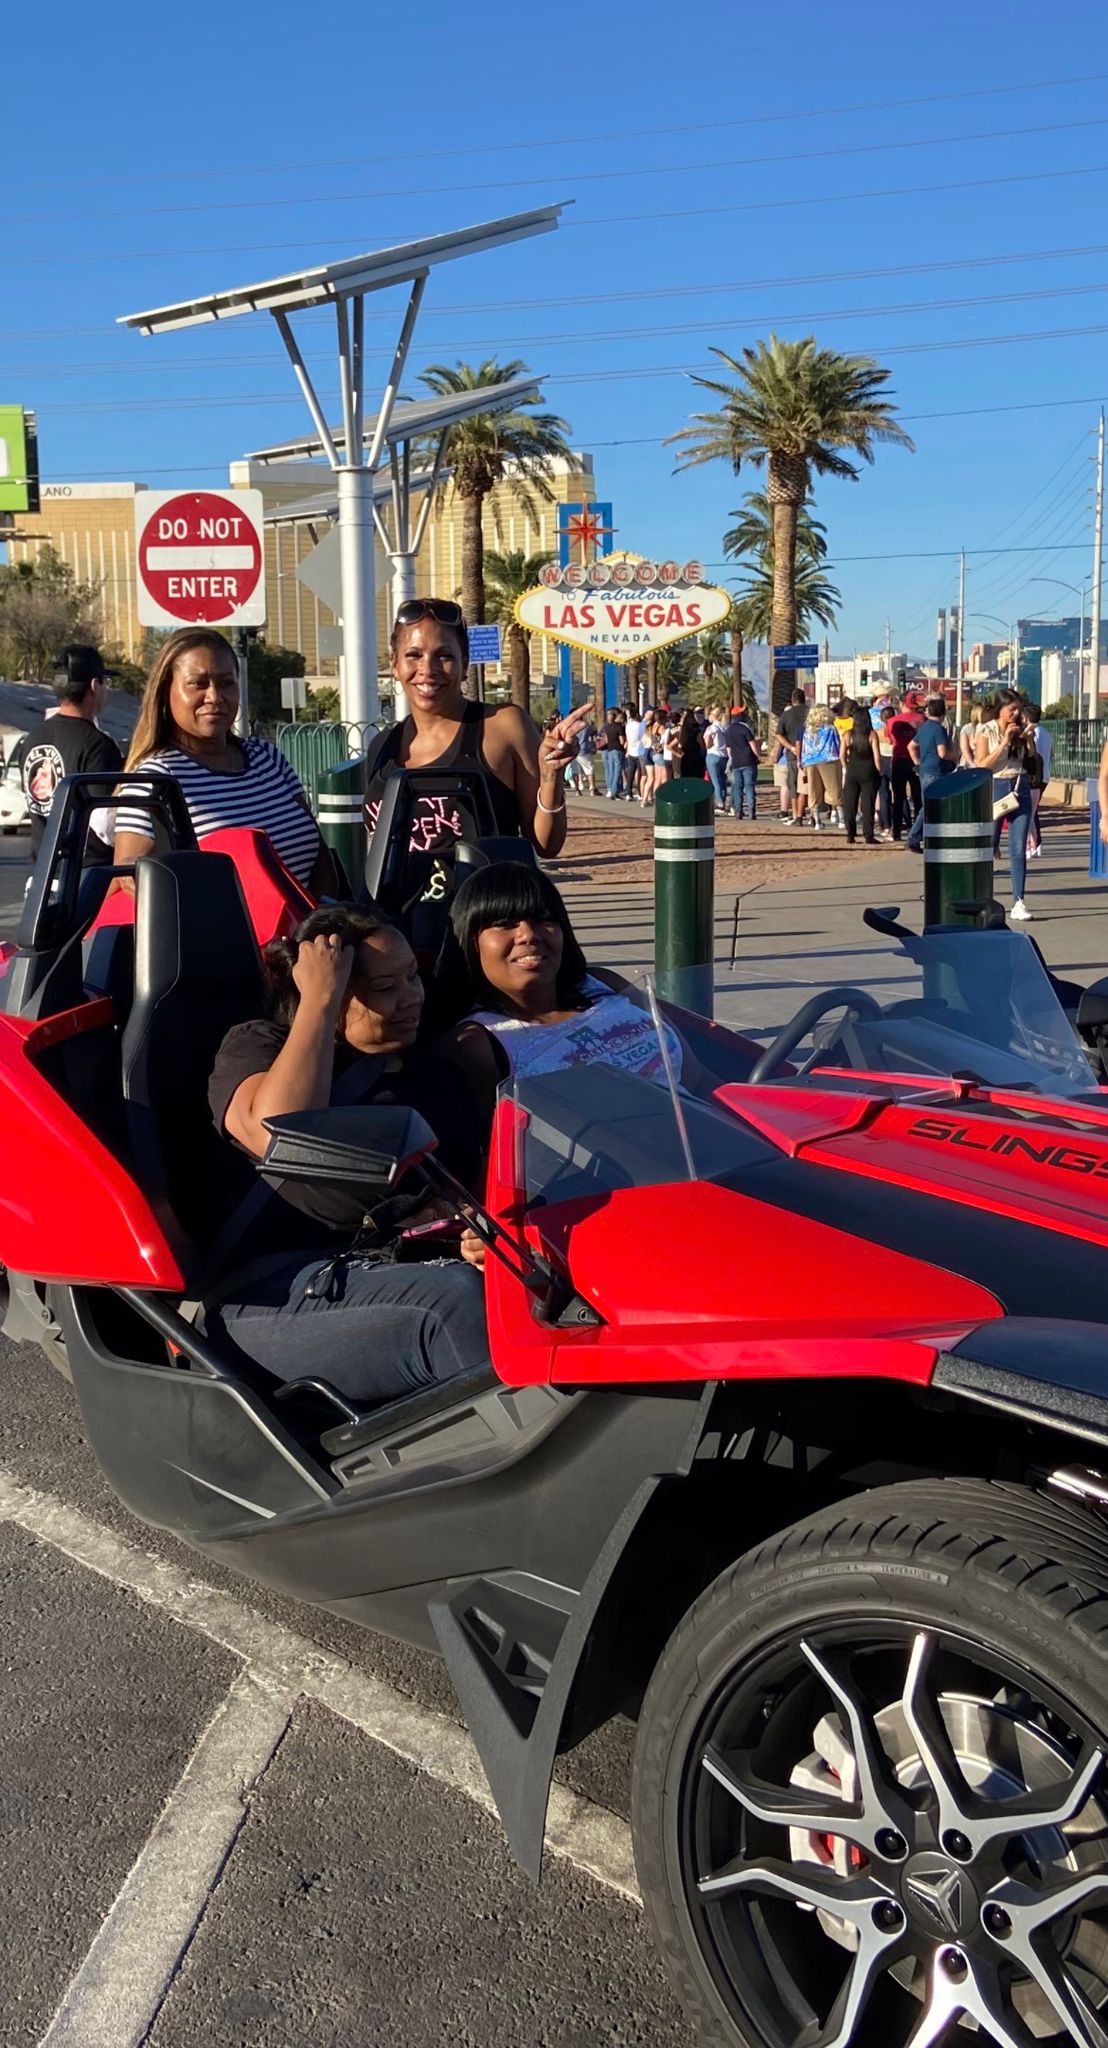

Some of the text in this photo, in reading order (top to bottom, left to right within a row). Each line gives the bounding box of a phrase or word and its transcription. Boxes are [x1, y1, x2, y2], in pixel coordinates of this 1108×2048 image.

[41, 486, 72, 497] ANO
[158, 517, 243, 541] DO NOT
[541, 561, 703, 586] WELCOME
[168, 576, 238, 600] ENTER
[582, 586, 680, 602] Fabulous
[544, 603, 702, 628] LAS VEGAS
[590, 633, 652, 644] NEVADA
[905, 681, 924, 691] TAO
